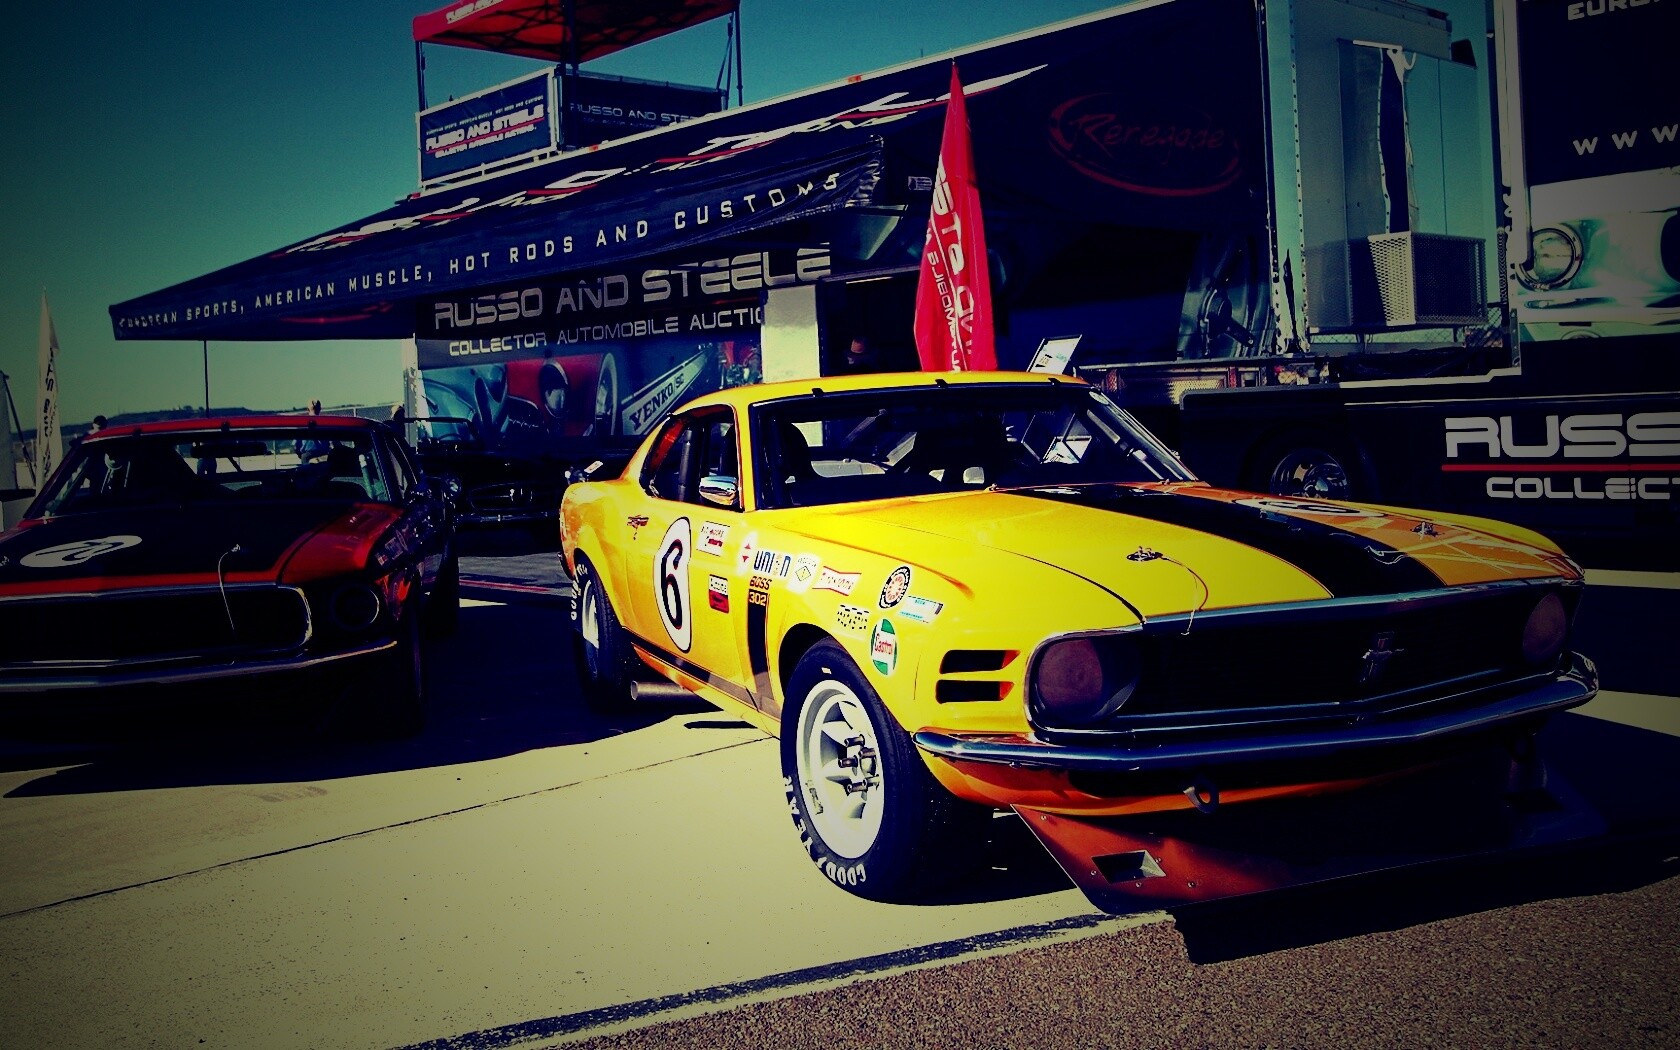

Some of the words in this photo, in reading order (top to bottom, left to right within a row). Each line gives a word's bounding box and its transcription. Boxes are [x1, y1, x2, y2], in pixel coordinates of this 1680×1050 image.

[628, 110, 656, 120] AND
[186, 300, 244, 321] SPORTS,
[255, 282, 335, 308] AMERICAN
[348, 264, 432, 292] MUSCLE,
[450, 252, 490, 274] HOT
[509, 236, 573, 263] RODS
[596, 220, 648, 247] AND
[674, 172, 840, 230] CUSTOMS
[434, 287, 543, 330] RUSSO
[556, 274, 629, 314] AND
[641, 241, 831, 303] STEELE
[450, 331, 548, 356] COLLECTOR
[556, 316, 680, 345] AUTOMOBILE
[629, 382, 674, 431] YENKO
[660, 538, 683, 630] 6
[748, 590, 767, 606] 302
[749, 575, 772, 590] BOSS
